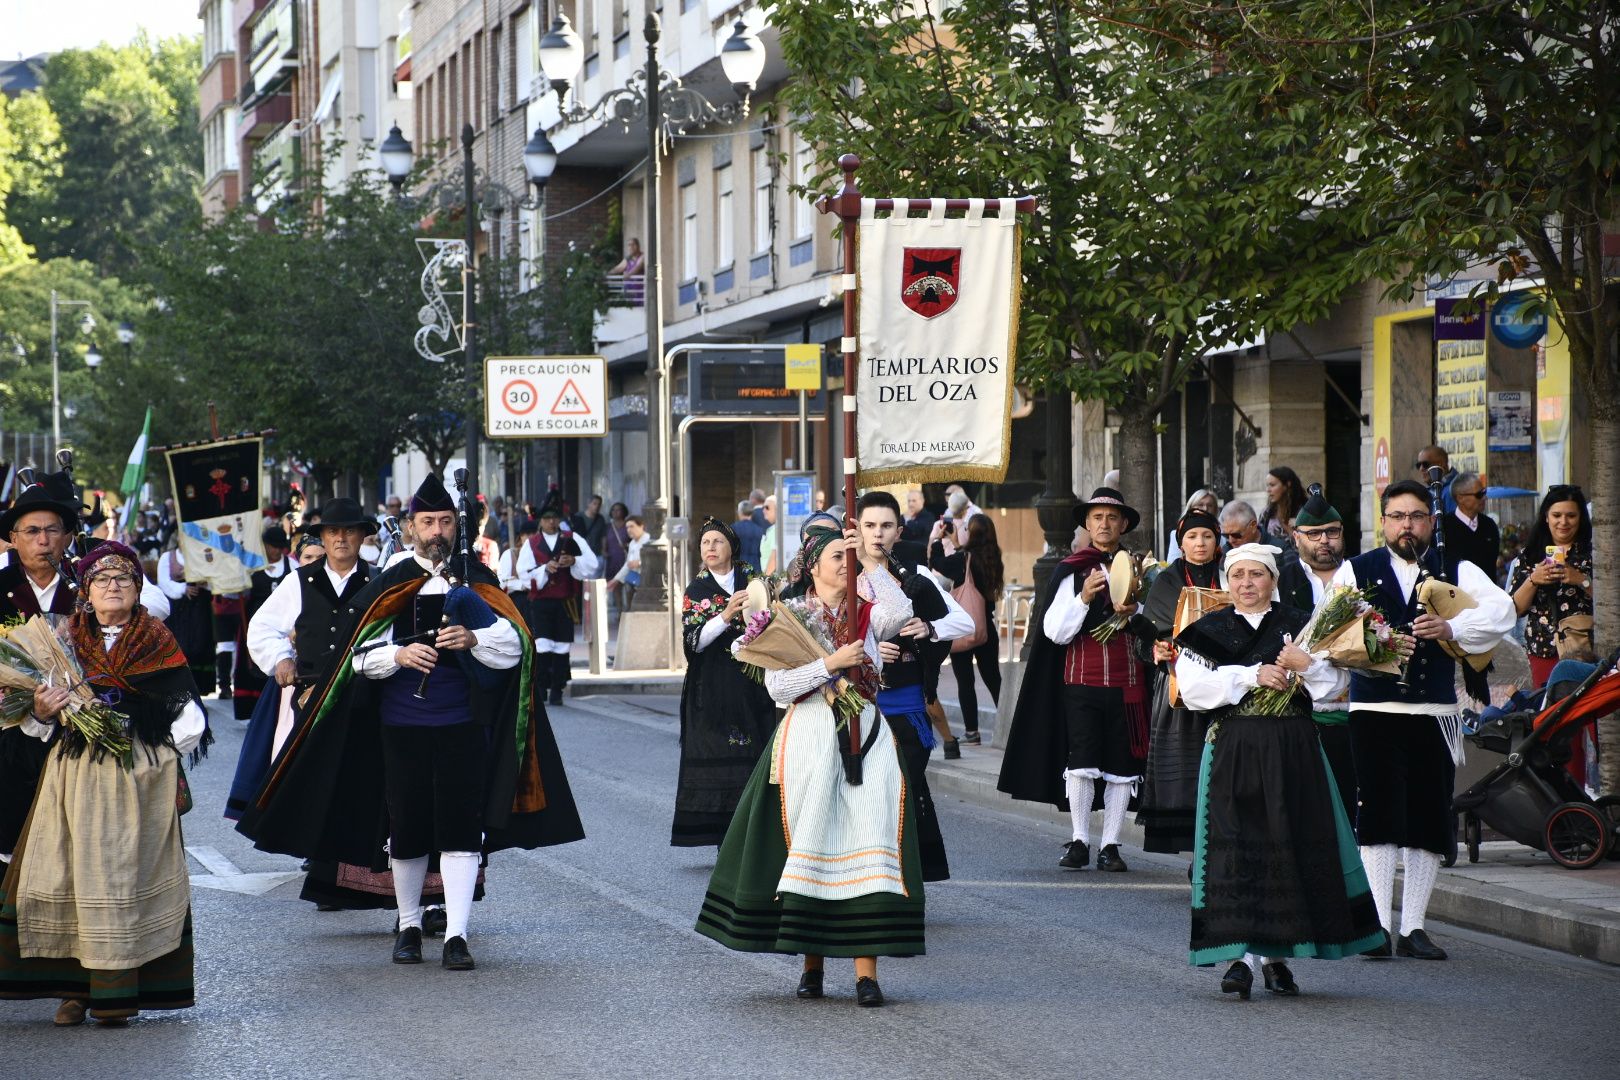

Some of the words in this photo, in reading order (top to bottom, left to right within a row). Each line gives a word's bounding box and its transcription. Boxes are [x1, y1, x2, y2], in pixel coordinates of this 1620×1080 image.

[500, 363, 591, 375] PRECAUCIÓN
[867, 357, 999, 377] TEMPLARIOS
[509, 391, 530, 403] 30
[879, 385, 917, 403] DEL
[929, 381, 978, 401] OZA
[495, 420, 531, 430] ZONA
[537, 419, 598, 430] ESCOLAR
[880, 443, 909, 454] TORAL
[912, 442, 926, 452] DE
[929, 441, 975, 452] MERAYO
[1376, 445, 1389, 478] ria
